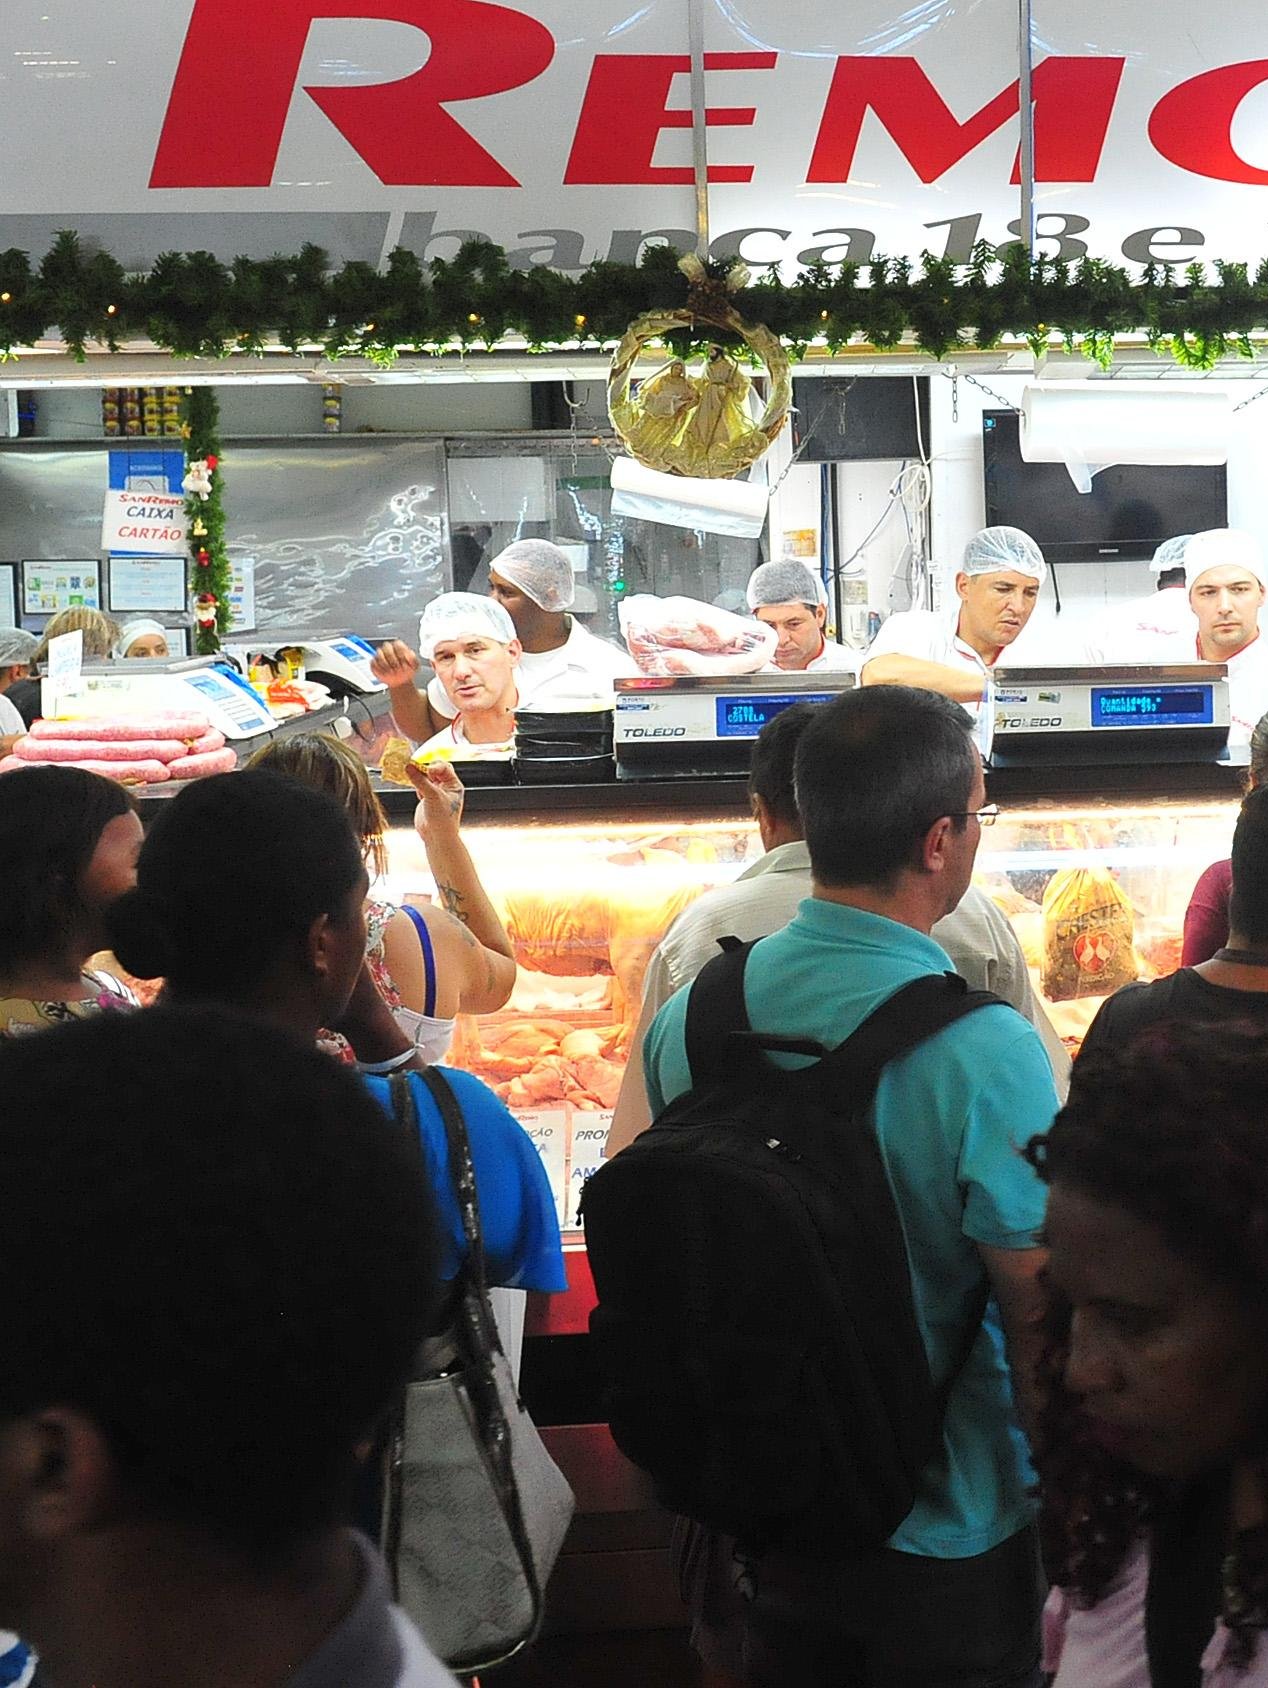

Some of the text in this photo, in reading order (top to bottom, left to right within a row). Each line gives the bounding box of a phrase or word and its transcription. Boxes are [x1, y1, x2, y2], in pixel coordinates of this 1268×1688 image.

[396, 211, 873, 268] banca
[922, 212, 1091, 266] 18
[1121, 226, 1206, 265] e
[126, 505, 175, 520] CAIXA
[117, 525, 182, 541] CARTÃO
[623, 726, 687, 738] TOLEDO
